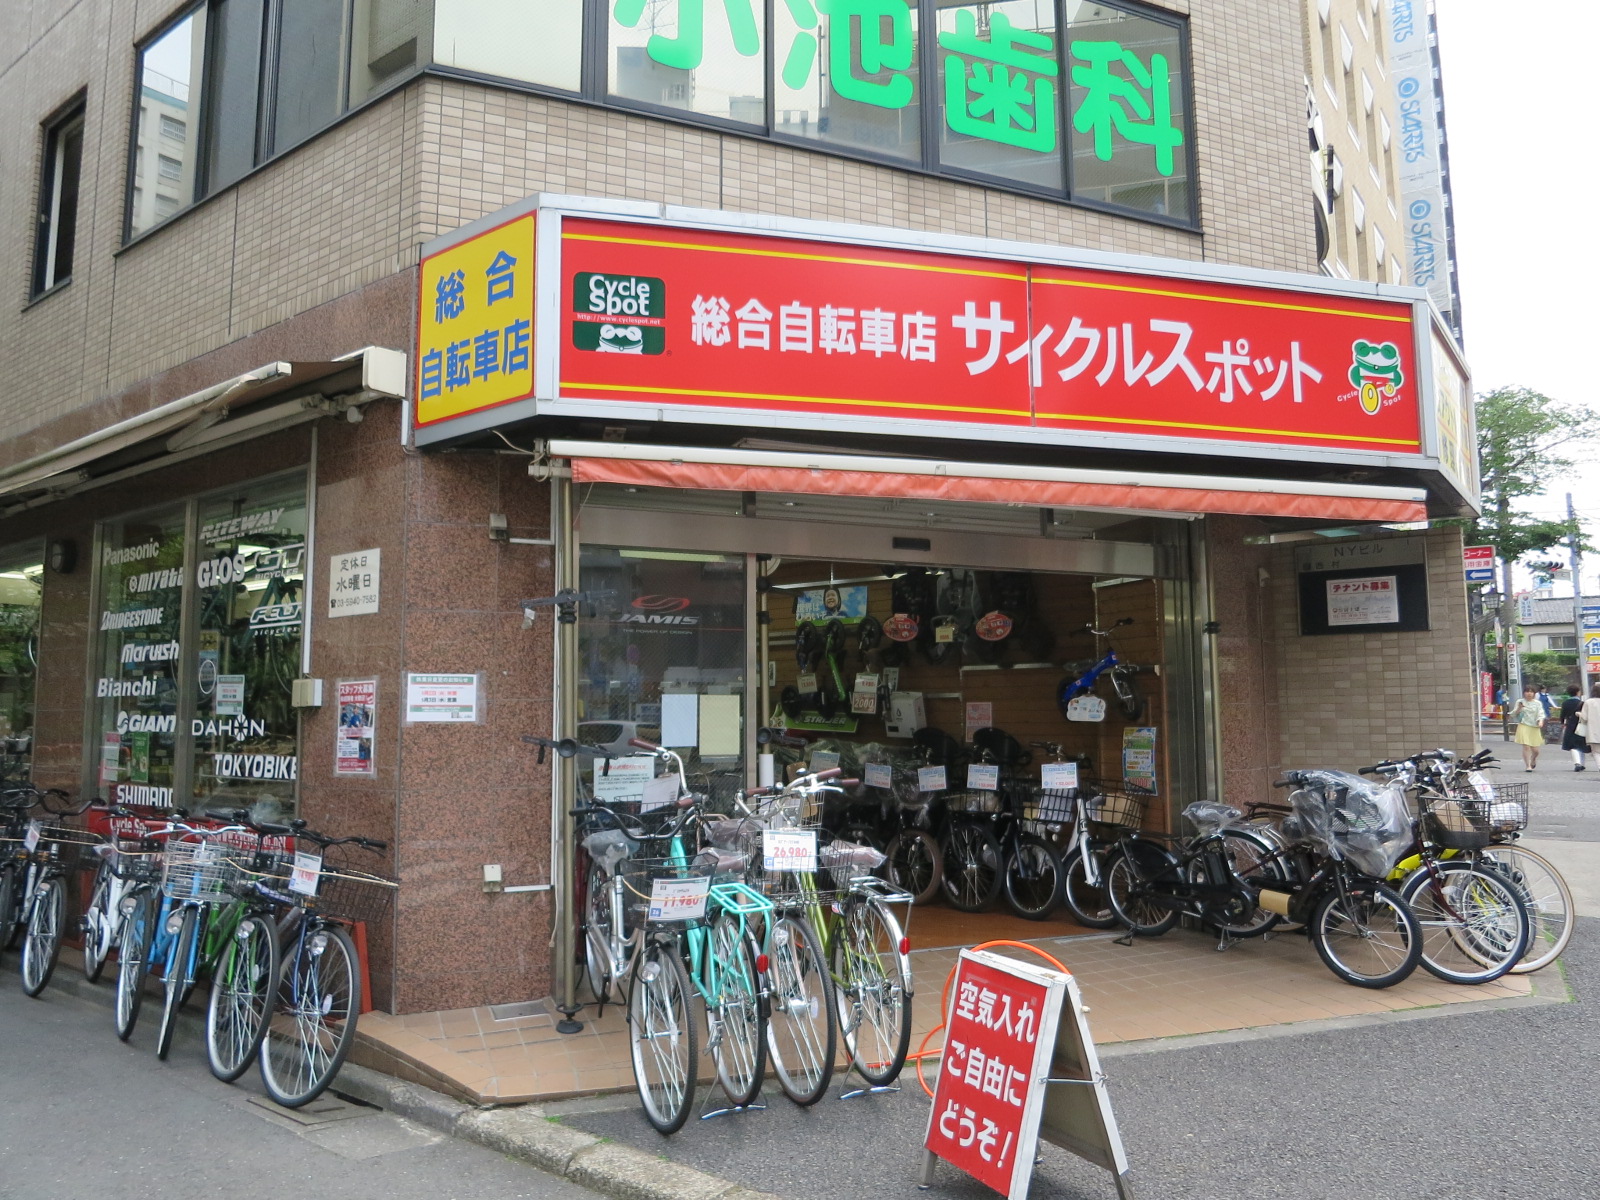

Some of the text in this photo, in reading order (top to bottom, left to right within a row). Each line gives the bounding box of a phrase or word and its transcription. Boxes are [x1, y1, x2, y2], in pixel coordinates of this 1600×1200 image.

[435, 251, 517, 324] 総合
[588, 275, 650, 298] Cycle
[588, 291, 650, 316] Spot
[577, 312, 661, 326] http://www.cyclespot.net
[420, 318, 531, 401] 自転車店
[691, 294, 1323, 403] 総合自転車店 サイクルスポット
[1337, 390, 1358, 402] Cycle
[1383, 394, 1402, 407] Spot
[103, 537, 160, 566] Panasonic
[1333, 543, 1384, 557] NYビル
[197, 553, 245, 589] GIOS
[255, 567, 299, 581] BICYCLES
[340, 556, 368, 572] 定休日
[336, 573, 371, 593] 水曜日
[100, 607, 164, 631] BRIDGESTONE
[617, 613, 700, 625] JAMIS
[254, 626, 298, 637] bicycles
[97, 674, 157, 698] Bianchi
[128, 714, 177, 733] GIANT
[191, 714, 265, 741] DAHON
[215, 754, 297, 780] TOKYOBIKE
[956, 981, 1036, 1044] 空気入れ
[946, 1039, 1026, 1107] ご自由に
